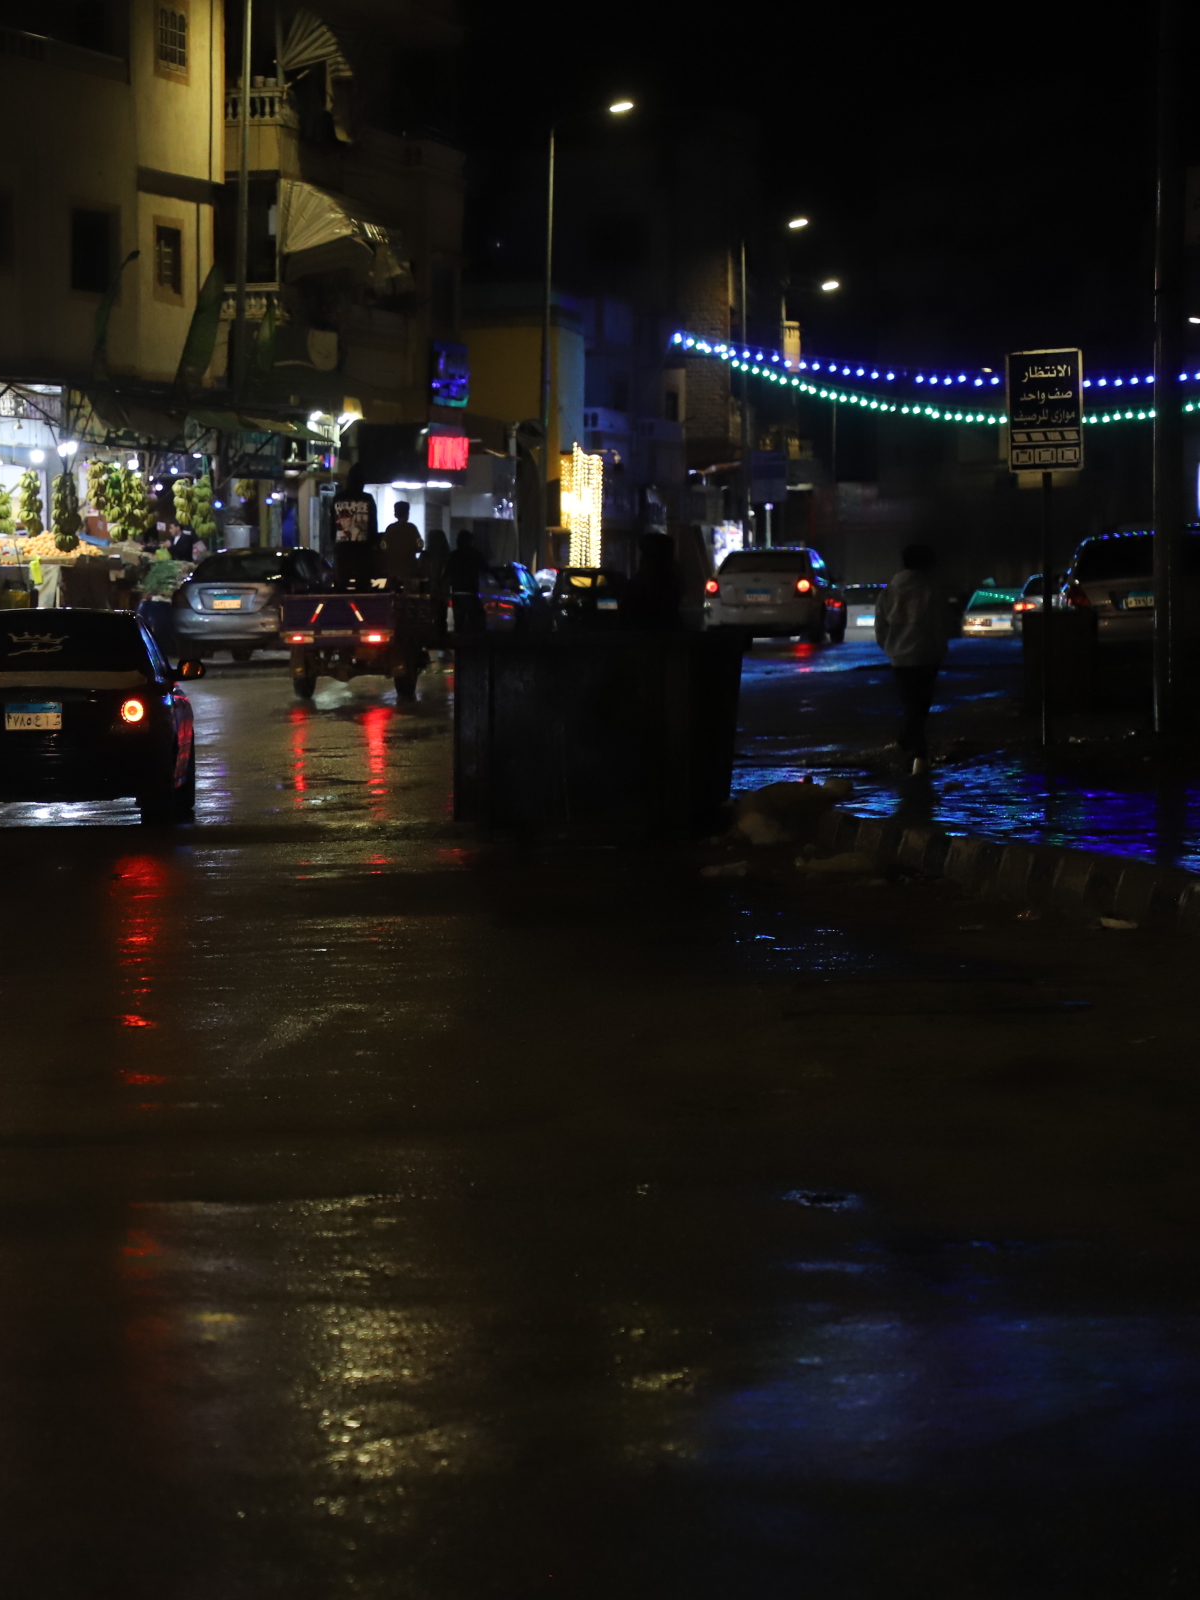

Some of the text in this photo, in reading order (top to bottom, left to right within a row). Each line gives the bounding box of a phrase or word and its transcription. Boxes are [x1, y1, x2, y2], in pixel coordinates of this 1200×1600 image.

[1022, 364, 1071, 382] الانتظار
[1020, 388, 1073, 404] صف واحد
[1014, 409, 1049, 425] للرصيف
